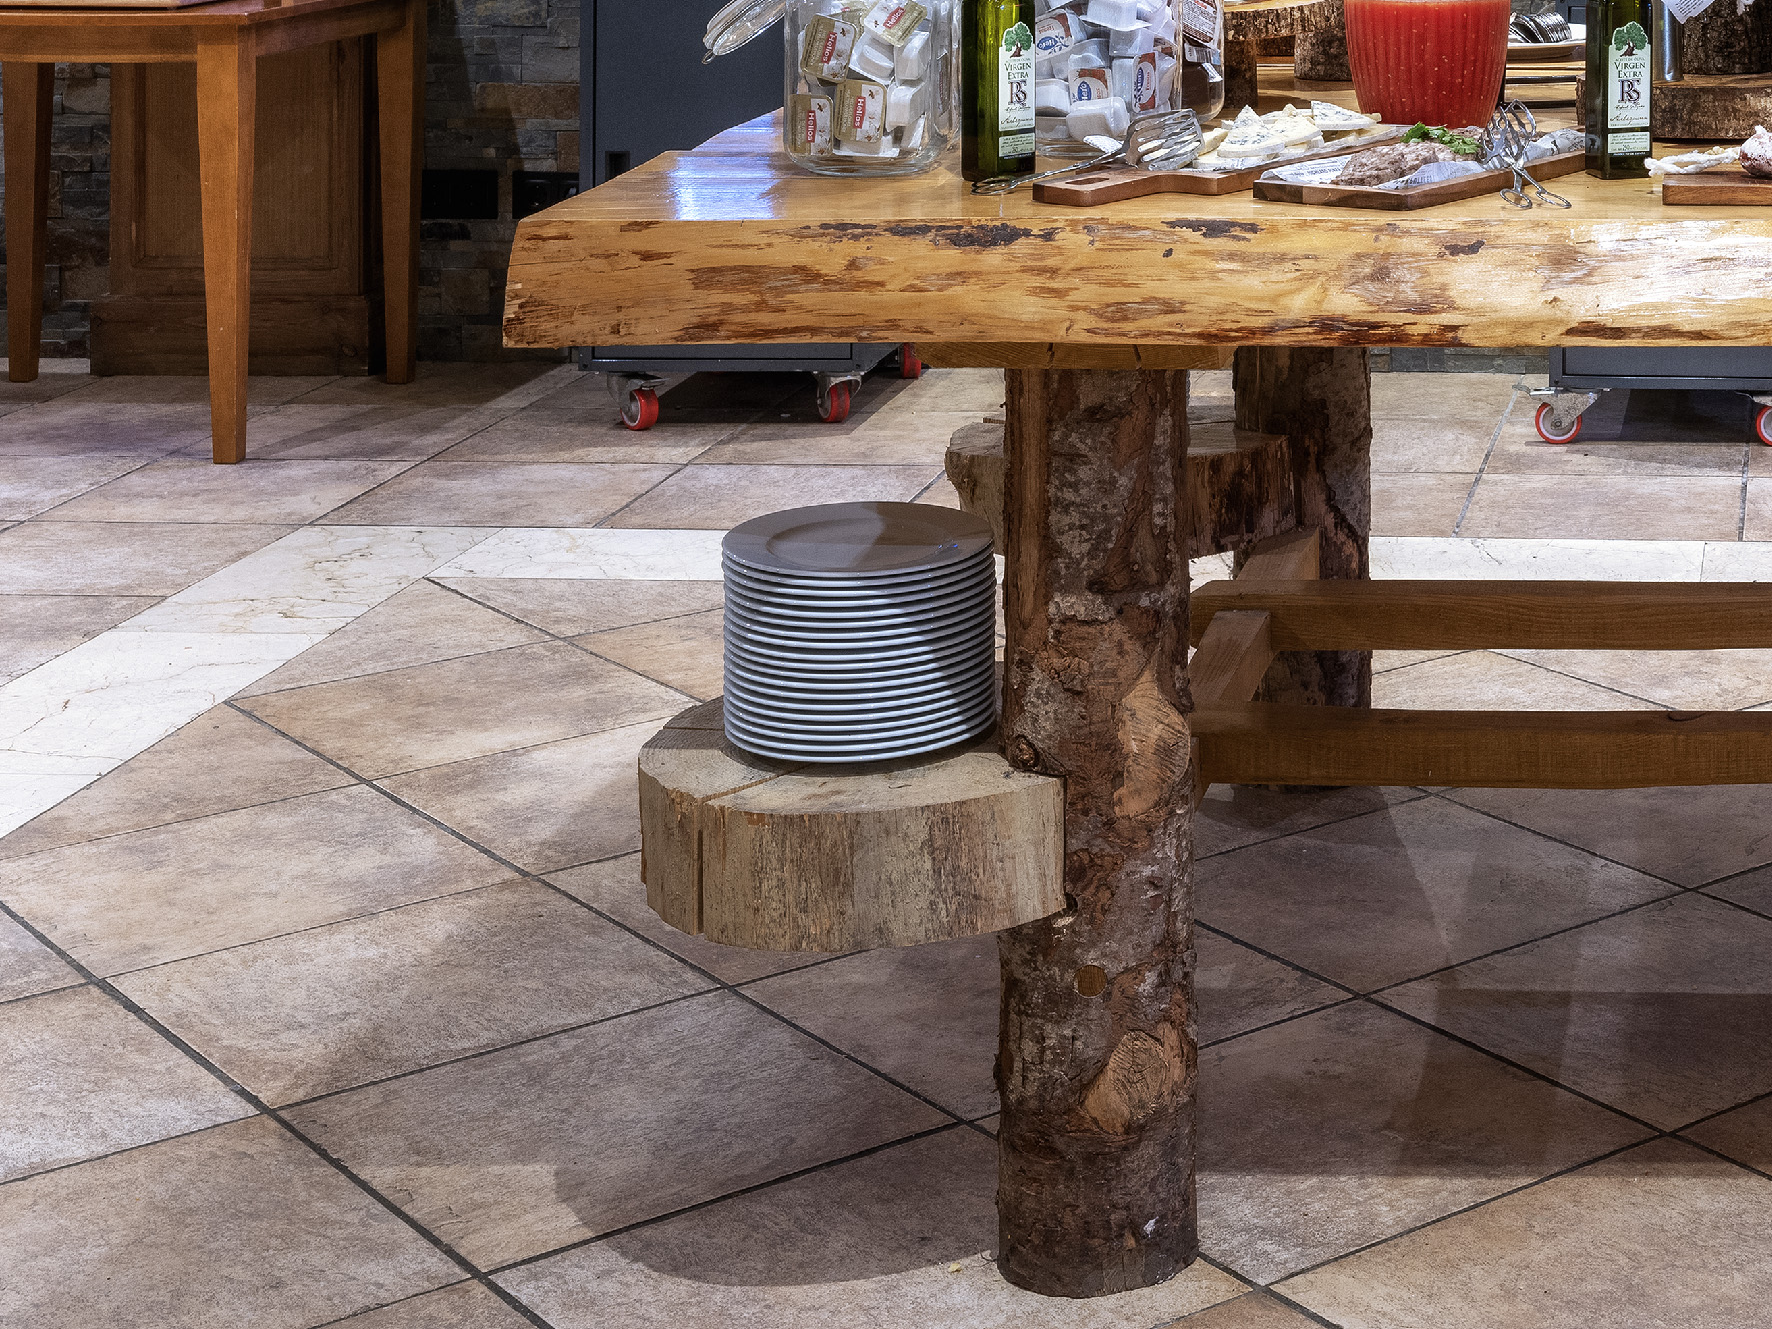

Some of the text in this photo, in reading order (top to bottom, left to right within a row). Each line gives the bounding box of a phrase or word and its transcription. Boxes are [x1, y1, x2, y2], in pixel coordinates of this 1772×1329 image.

[885, 7, 906, 29] Helios
[823, 33, 837, 63] Helios
[1037, 38, 1056, 50] Hero
[1004, 62, 1032, 71] VIRGEN
[1614, 62, 1646, 70] VIRGEN
[1007, 71, 1029, 80] EXTRA
[1618, 70, 1643, 78] EXTRA
[855, 97, 865, 128] Helios
[807, 111, 816, 142] Helios
